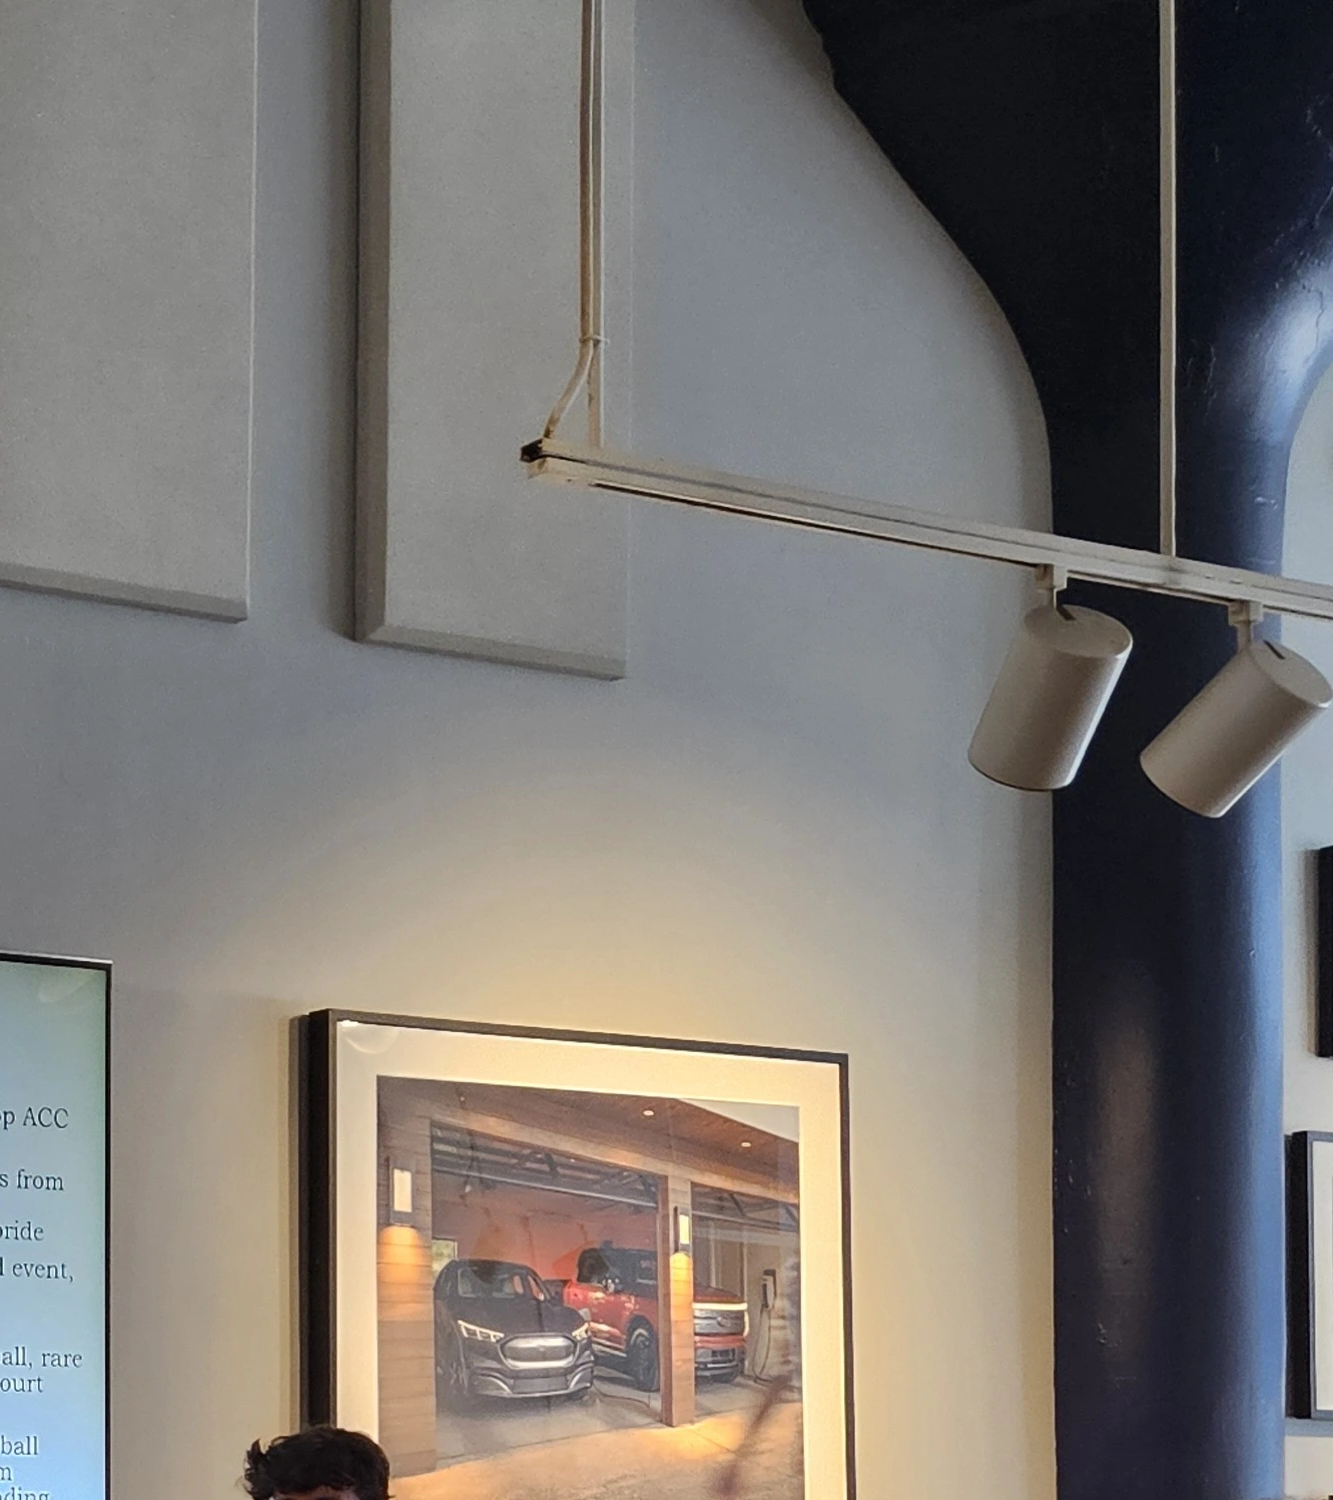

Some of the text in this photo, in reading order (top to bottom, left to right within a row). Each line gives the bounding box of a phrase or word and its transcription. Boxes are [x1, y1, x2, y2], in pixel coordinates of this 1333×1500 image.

[22, 1107, 69, 1129] ACC
[16, 1169, 64, 1191] from
[12, 1259, 74, 1283] event,
[42, 1351, 83, 1368] rare
